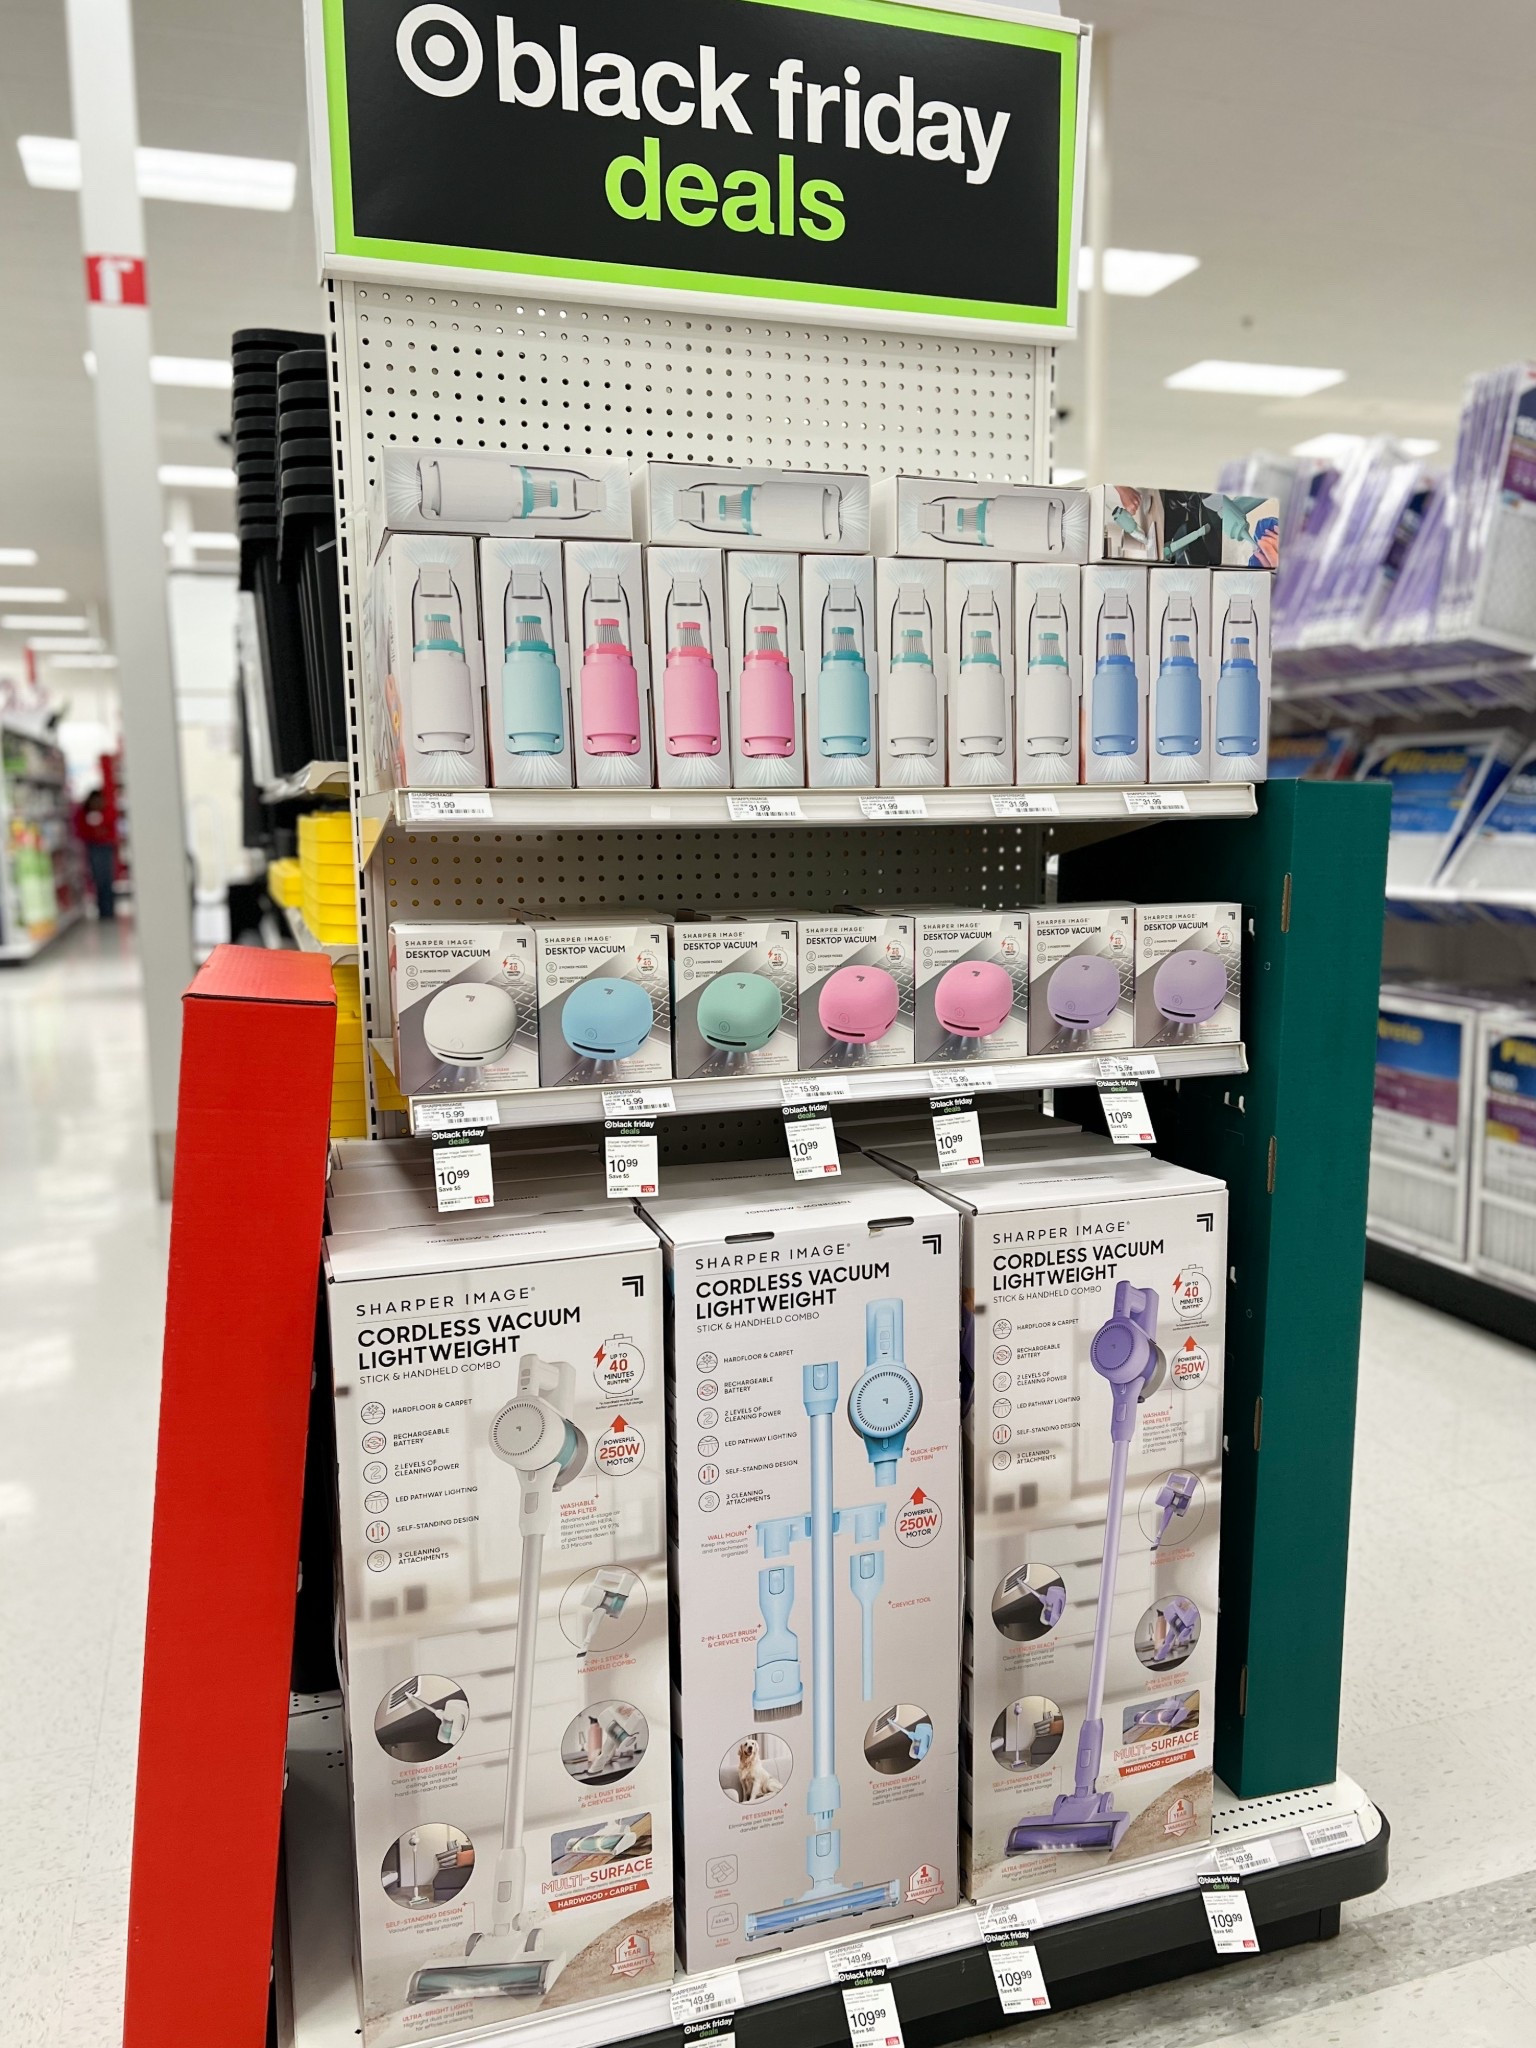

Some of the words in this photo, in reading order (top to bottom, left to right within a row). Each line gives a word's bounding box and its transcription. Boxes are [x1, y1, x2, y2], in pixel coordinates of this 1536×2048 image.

[496, 15, 753, 135] black
[769, 58, 1011, 185] friday
[604, 136, 847, 242] deals
[430, 800, 455, 810] 31.99
[877, 802, 898, 811] 31.99
[1008, 800, 1029, 808] 31.99
[1142, 797, 1162, 806] 31.99
[748, 804, 771, 812] 31.99
[1036, 927, 1070, 936] DESKTOP
[1072, 926, 1101, 934] VACUUM
[1143, 922, 1177, 931] DESKTOP
[1179, 921, 1208, 929] VACUUM
[806, 936, 842, 945] DESKTOP
[844, 935, 877, 944] VACUUM
[923, 933, 958, 941] DESKTOP
[960, 931, 992, 939] VACUUM
[545, 947, 587, 956] DESKTOP
[588, 945, 626, 954] VACUUM
[683, 941, 721, 951] DESKTOP
[723, 940, 758, 949] VACUUM
[405, 949, 449, 959] DESKTOP
[451, 949, 491, 958] VACUUM
[799, 1085, 820, 1093] 15.99
[621, 1097, 643, 1105] 15.99
[936, 1100, 954, 1108] black
[954, 1098, 973, 1106] friday
[789, 1105, 808, 1114] black
[808, 1103, 828, 1112] friday
[441, 1110, 465, 1119] 15.99
[612, 1120, 632, 1128] black
[633, 1120, 655, 1129] friday
[439, 1130, 461, 1140] black
[462, 1128, 485, 1137] friday
[620, 1127, 640, 1135] deals
[448, 1137, 470, 1146] deals
[992, 1227, 1067, 1244] SHARPER
[1076, 1221, 1126, 1236] IMAGE
[695, 1251, 780, 1270] SHARPER
[790, 1243, 845, 1260] IMAGE
[993, 1248, 1087, 1271] CORDLESS
[1092, 1239, 1164, 1260] VACUUM
[696, 1271, 802, 1298] CORDLESS
[808, 1262, 890, 1286] VACUUM
[993, 1263, 1118, 1291] LIGHTWEIGHT
[993, 1294, 1017, 1304] STICK
[1018, 1293, 1025, 1301] &
[1026, 1288, 1069, 1300] HANDHELD
[1071, 1285, 1102, 1295] COMBO
[1184, 1287, 1199, 1298] 40
[356, 1296, 454, 1317] SHARPER
[465, 1288, 529, 1305] IMAGE
[696, 1288, 837, 1320] LIGHTWEIGHT
[1179, 1297, 1204, 1306] MINUTES
[357, 1318, 481, 1348] CORDLESS
[487, 1306, 580, 1332] VACUUM
[696, 1323, 723, 1333] STICK
[725, 1322, 732, 1330] &
[734, 1315, 783, 1329] HANDHELD
[785, 1311, 820, 1322] COMBO
[358, 1335, 520, 1370] LIGHTWEIGHT
[1016, 1343, 1061, 1353] RECHARGEABLE
[723, 1355, 762, 1364] HARDFLOOR
[769, 1350, 794, 1358] CARPET
[1016, 1352, 1041, 1360] BATTERY
[1177, 1355, 1202, 1363] POWERFUL
[609, 1359, 628, 1372] 40
[1174, 1361, 1206, 1376] 250W
[359, 1373, 390, 1384] STICK
[392, 1372, 400, 1381] &
[403, 1365, 459, 1379] HANDHELD
[461, 1360, 501, 1373] COMBO
[604, 1370, 634, 1381] MINUTES
[1179, 1373, 1200, 1382] MOTOR
[724, 1376, 773, 1387] RECHARGEABLE
[724, 1386, 751, 1394] BATTERY
[392, 1403, 436, 1414] HARDFLOOR
[444, 1399, 473, 1408] CARPET
[393, 1428, 450, 1440] RECHARGEABLE
[1016, 1426, 1060, 1436] SELF-STANDING
[1060, 1422, 1081, 1431] DESIGN
[393, 1438, 424, 1447] BATTERY
[603, 1436, 635, 1446] POWERFUL
[737, 1436, 766, 1446] PATHWAY
[767, 1431, 798, 1442] LIGHTING
[599, 1442, 640, 1460] 250W
[400, 1462, 426, 1470] LEVELS
[606, 1456, 634, 1467] MOTOR
[725, 1463, 774, 1475] SELF-STANDING
[775, 1459, 798, 1469] DESIGN
[394, 1467, 425, 1477] CLEANING
[428, 1463, 460, 1473] POWER
[395, 1495, 408, 1503] LED
[410, 1490, 443, 1501] PATHWAY
[444, 1486, 478, 1497] LIGHTING
[726, 1494, 771, 1506] ATTACHMENTS
[903, 1508, 933, 1518] POWERFUL
[397, 1520, 452, 1533] SELF-STANDING
[453, 1515, 480, 1526] DESIGN
[899, 1515, 938, 1532] 250W
[905, 1528, 932, 1538] MOTOR
[404, 1547, 440, 1558] CLEANING
[398, 1553, 449, 1565] ATTACHMENTS
[541, 1857, 653, 1895] MULTI-SURFACE
[1204, 1876, 1220, 1885] black
[1221, 1875, 1240, 1885] friday
[1213, 1882, 1229, 1890] deals
[557, 1892, 603, 1909] HARDWOOD
[609, 1882, 638, 1896] CARPET
[990, 1932, 1009, 1943] black
[1010, 1930, 1030, 1942] friday
[1000, 1938, 1018, 1947] deals
[846, 1952, 872, 1966] 149.99
[844, 1969, 864, 1981] black
[865, 1967, 885, 1979] friday
[854, 1976, 873, 1986] deals
[688, 1993, 715, 2007] 149.99
[690, 2019, 711, 2033] black
[711, 2017, 733, 2030] friday
[699, 2027, 718, 2037] deals
